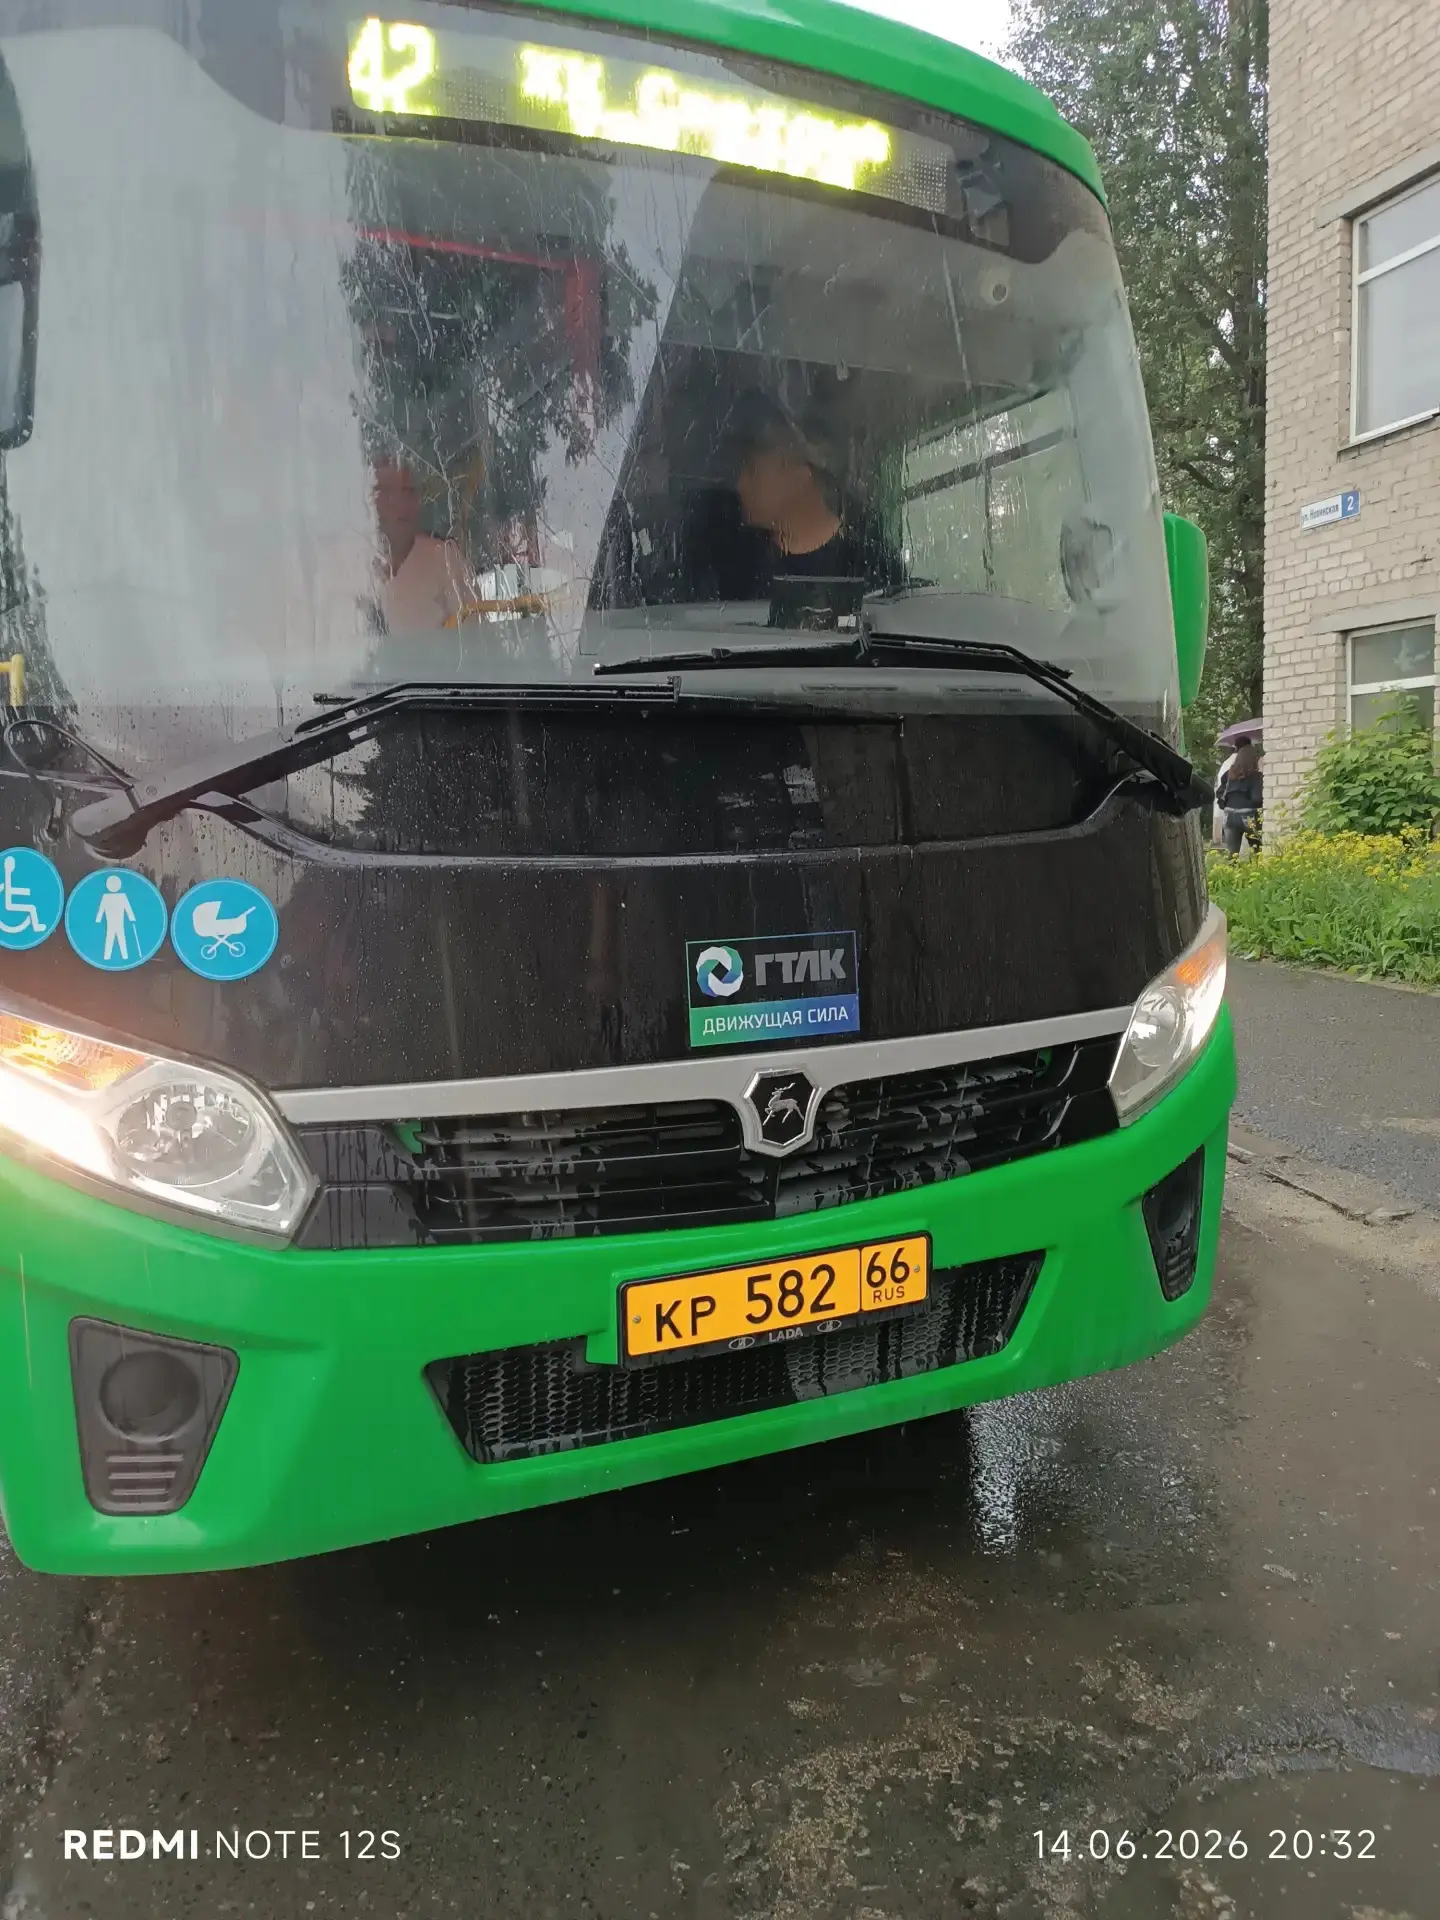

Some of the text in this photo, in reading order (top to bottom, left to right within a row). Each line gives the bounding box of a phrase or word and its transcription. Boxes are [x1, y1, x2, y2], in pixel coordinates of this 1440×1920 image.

[349, 18, 437, 114] 42
[1347, 495, 1354, 511] 2
[755, 949, 846, 986] ГТЛК
[703, 1006, 849, 1036] ДВИЖУЩАЯ СИЛА
[745, 1264, 836, 1324] 582
[866, 1247, 910, 1288] 66
[873, 1286, 905, 1303] RUS
[768, 1327, 804, 1343] LADA
